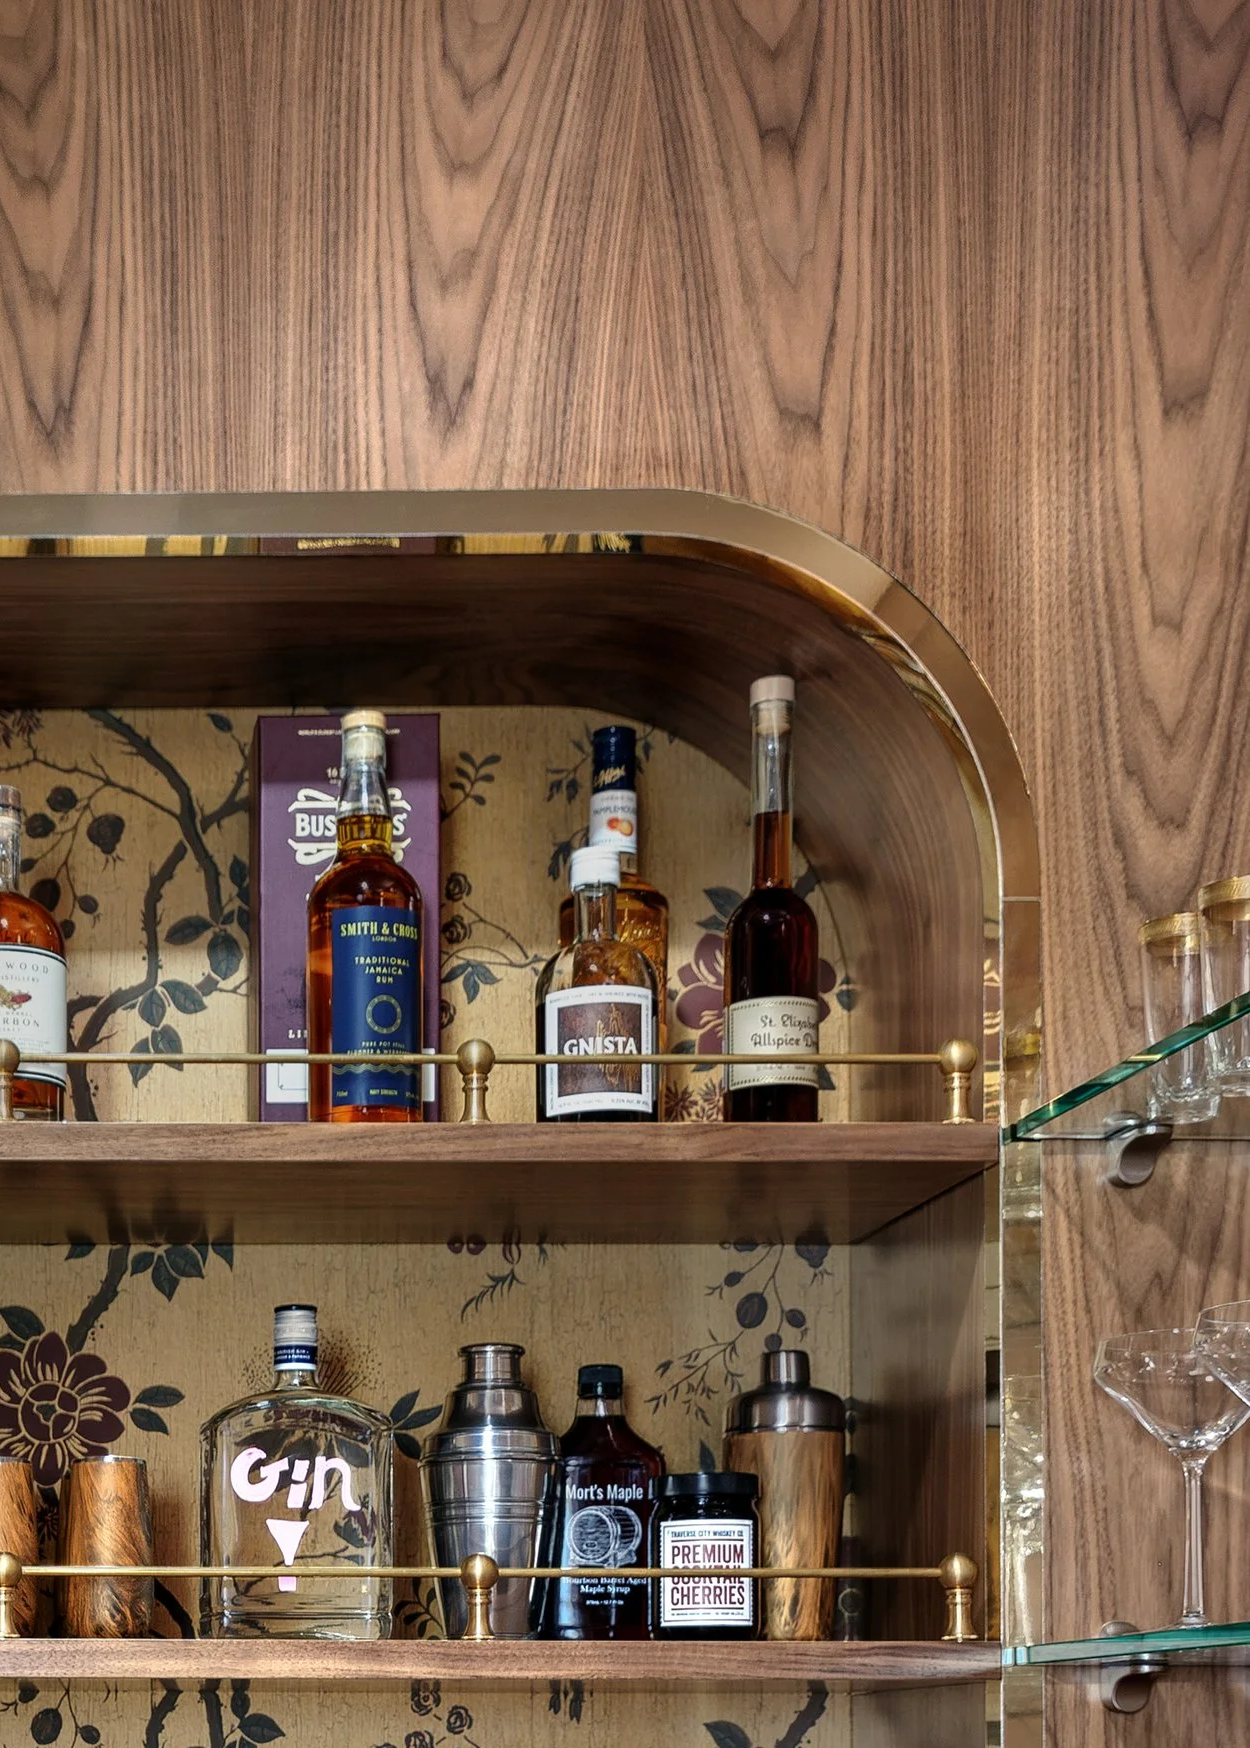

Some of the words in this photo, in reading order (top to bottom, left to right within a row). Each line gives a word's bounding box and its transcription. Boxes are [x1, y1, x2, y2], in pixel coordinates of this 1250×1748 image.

[340, 921, 378, 937] SMITH
[381, 922, 390, 935] &
[393, 922, 418, 940] CROSS
[354, 956, 410, 967] TRADITIONAL
[364, 966, 403, 976] JAMAICA
[376, 975, 394, 984] RUM
[563, 1036, 638, 1055] GNISTA
[750, 1032, 801, 1050] Allspice
[230, 1446, 362, 1512] Gin
[566, 1484, 604, 1500] Mort's
[606, 1484, 644, 1503] Maple
[671, 1530, 696, 1538] TRAVERSE
[671, 1544, 744, 1564] PREMIUM
[579, 1585, 605, 1594] Maple
[606, 1585, 631, 1594] Syrup
[671, 1585, 745, 1606] CHERRIES
